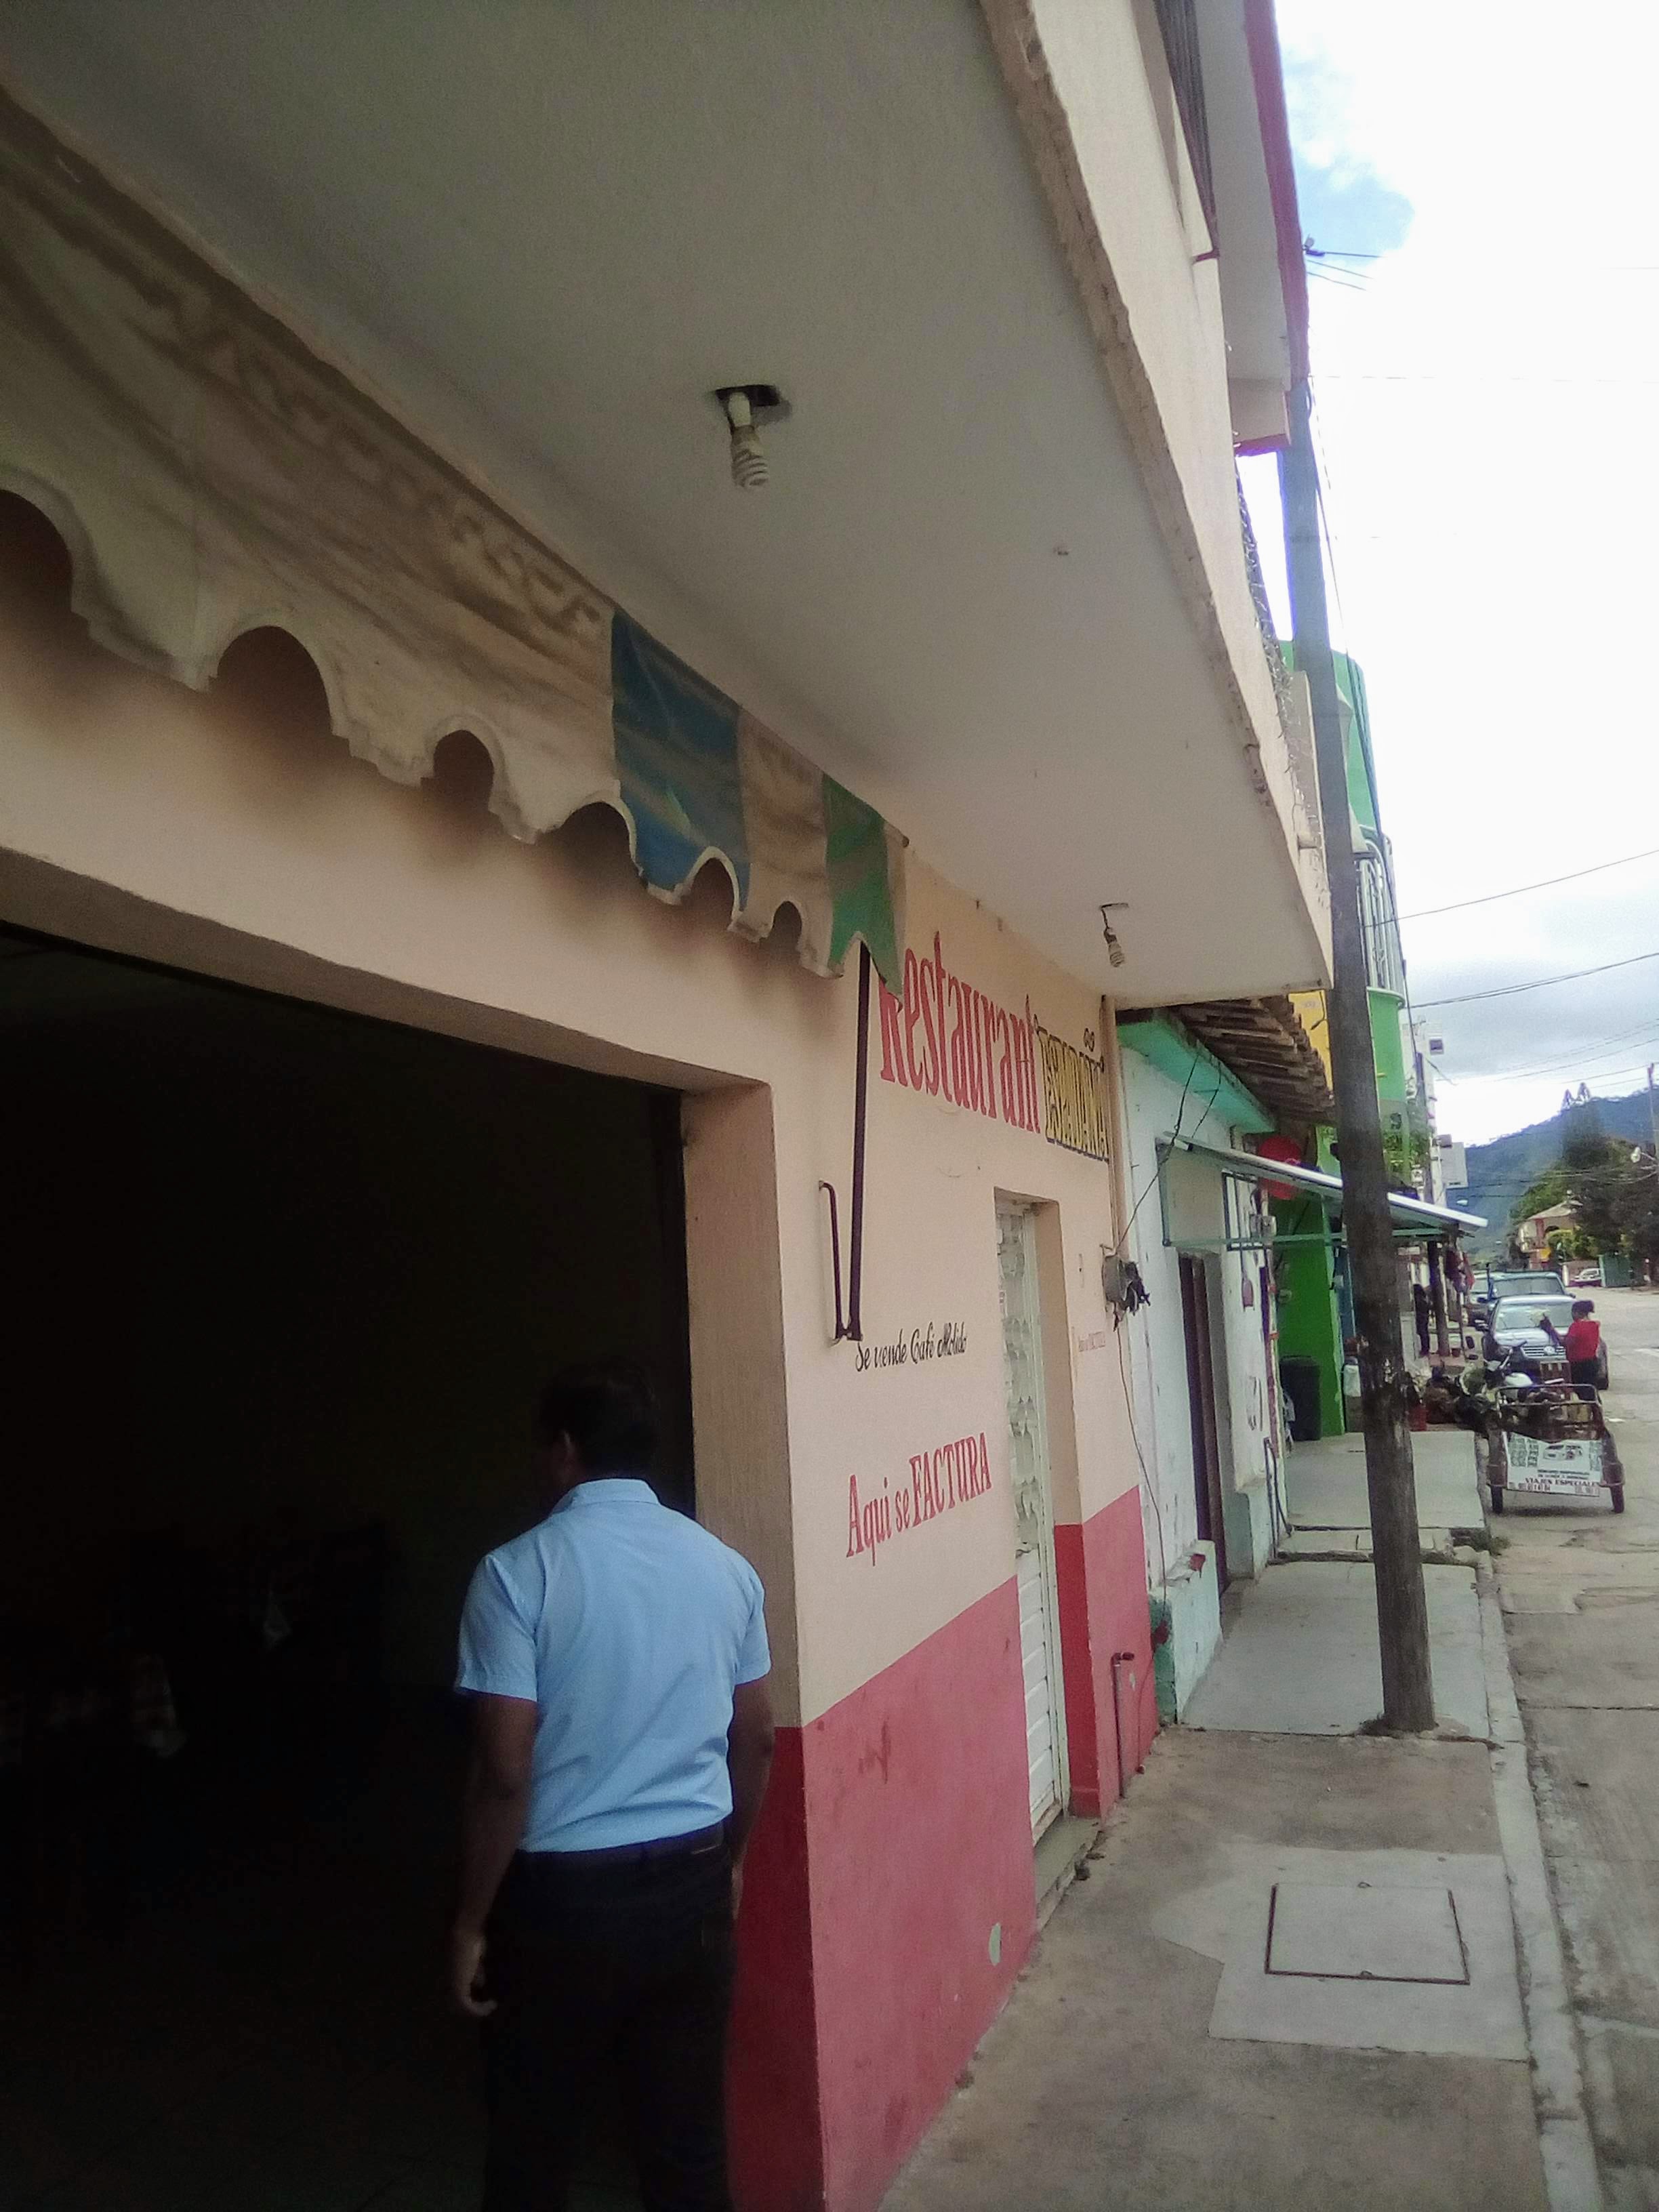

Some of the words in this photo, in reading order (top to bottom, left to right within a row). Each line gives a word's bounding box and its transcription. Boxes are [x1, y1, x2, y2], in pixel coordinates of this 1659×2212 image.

[879, 931, 1041, 1133] Restaurant
[855, 1341, 872, 1372] Se
[875, 1328, 907, 1368] vende
[895, 1488, 910, 1533] se
[909, 1432, 991, 1528] FACTURA
